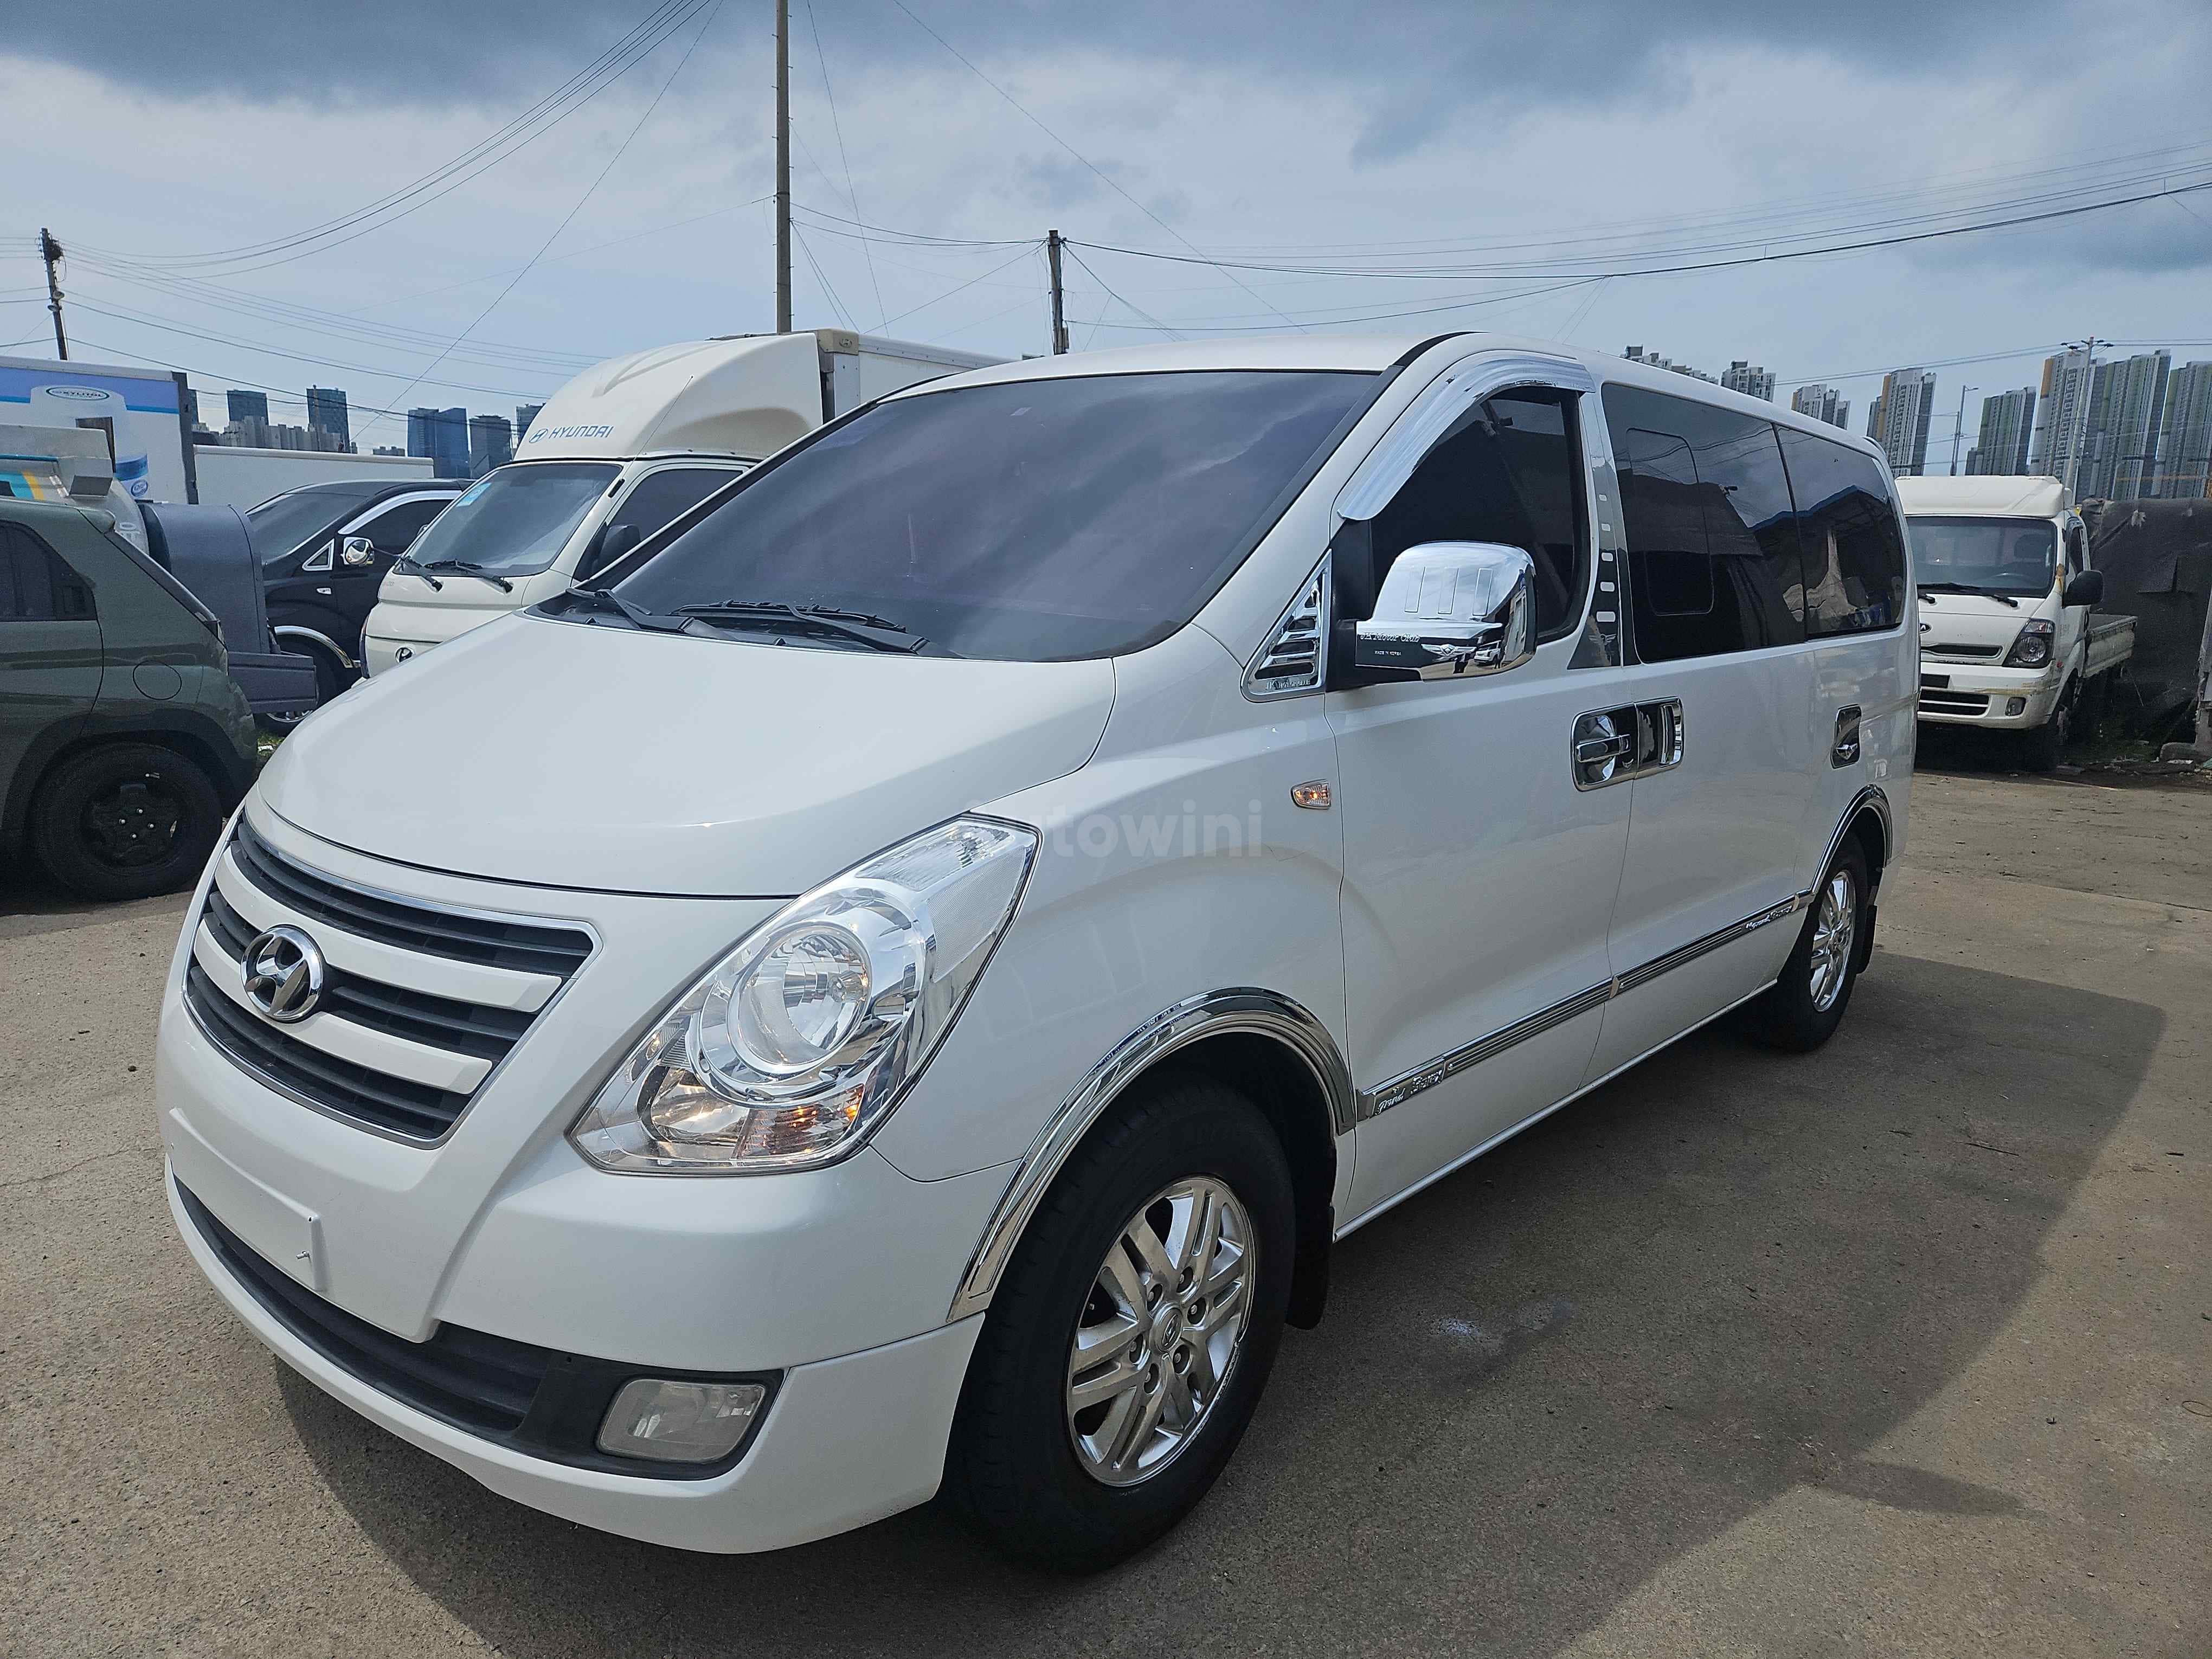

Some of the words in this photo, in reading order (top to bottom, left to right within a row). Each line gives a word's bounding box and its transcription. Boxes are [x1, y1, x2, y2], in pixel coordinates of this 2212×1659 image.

[549, 426, 614, 439] HYUNDAI
[1373, 632, 1399, 641] Motor
[1400, 633, 1420, 642] Club
